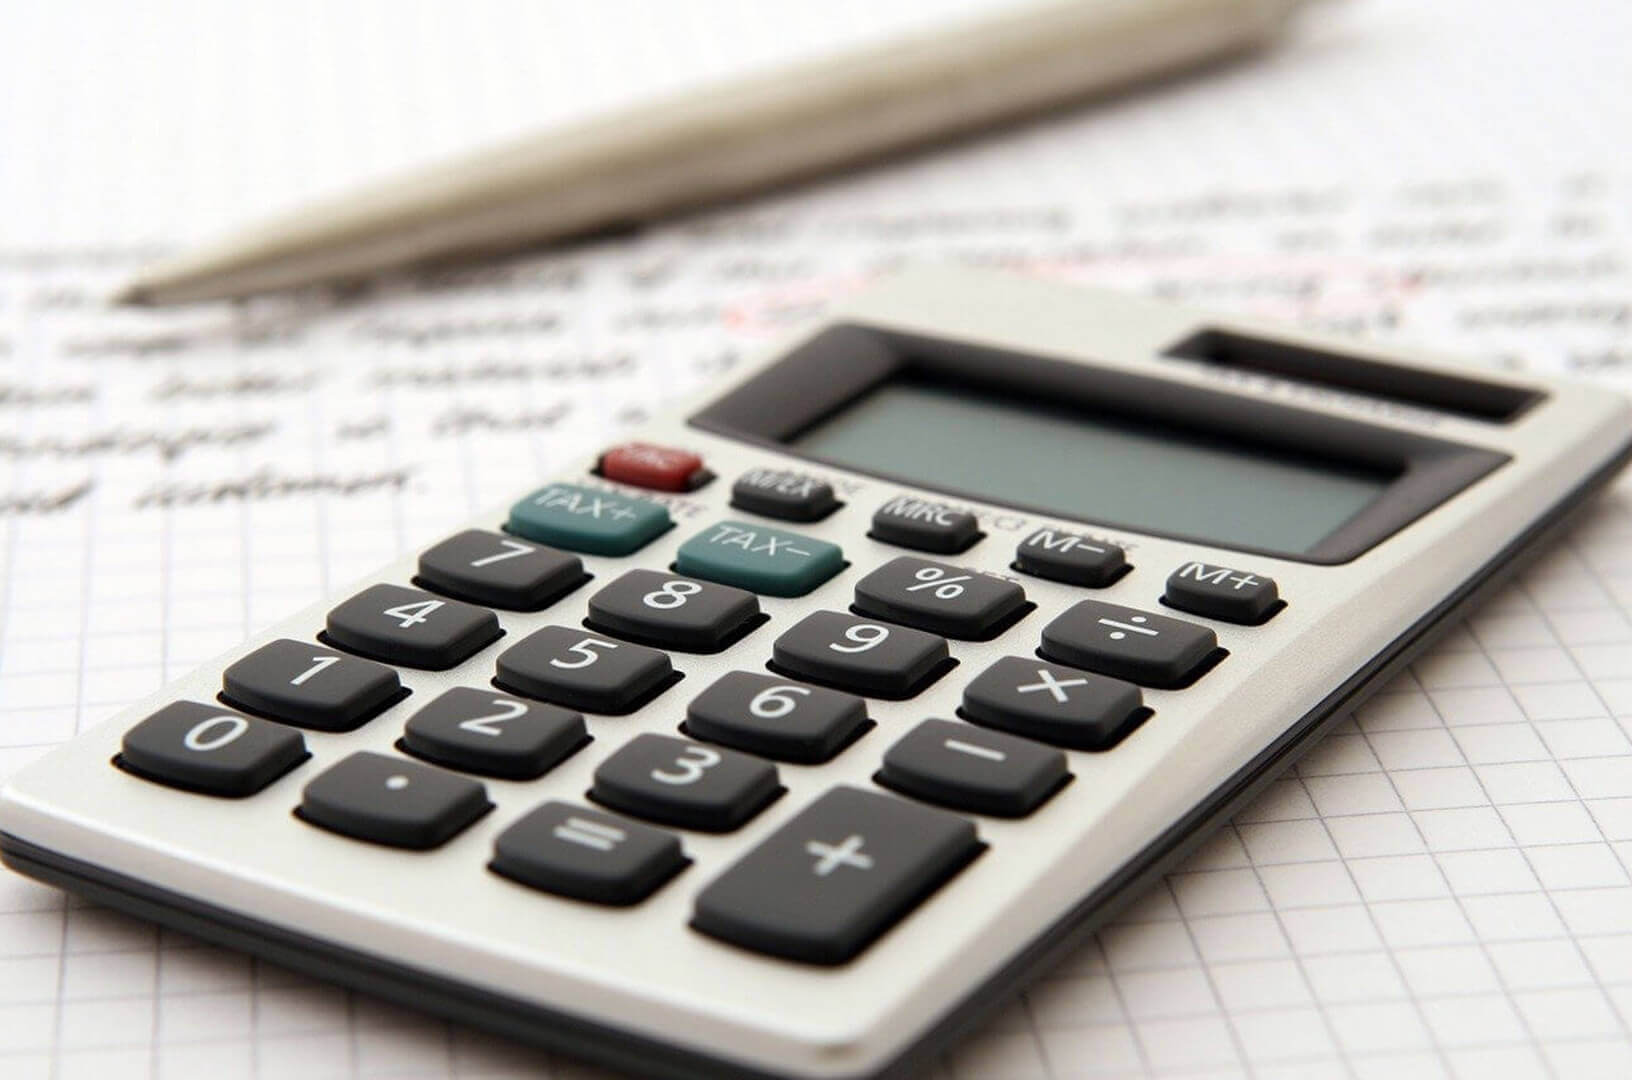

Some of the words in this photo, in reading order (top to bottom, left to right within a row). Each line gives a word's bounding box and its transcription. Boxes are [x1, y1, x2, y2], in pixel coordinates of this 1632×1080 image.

[534, 487, 638, 521] TAX+
[884, 496, 954, 526] MRC
[472, 540, 536, 566] 7
[708, 524, 811, 558] TAX-
[1027, 528, 1106, 554] M-
[906, 566, 973, 599] %
[1179, 562, 1260, 591] M+
[643, 581, 702, 608] 8
[384, 600, 445, 627] 4
[550, 638, 618, 668] 5
[830, 625, 889, 652] 9
[291, 657, 340, 685] 1
[750, 686, 810, 717] 6
[460, 700, 528, 735] 2
[185, 716, 248, 750] 0
[653, 747, 720, 784] 3
[556, 819, 623, 849] =
[809, 837, 869, 873] +
